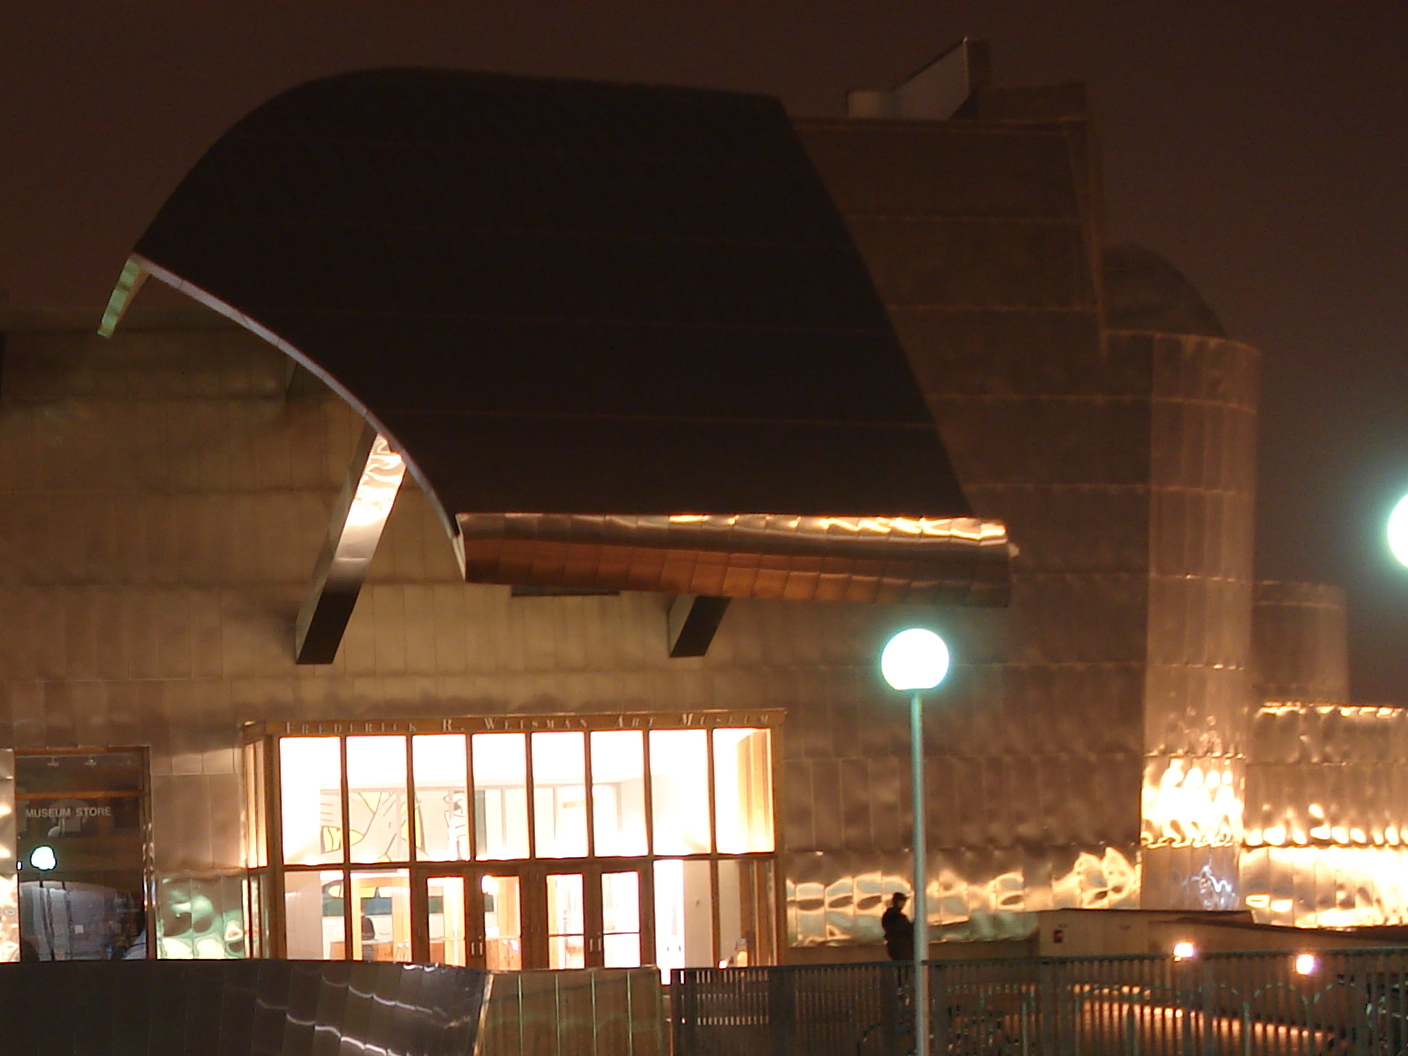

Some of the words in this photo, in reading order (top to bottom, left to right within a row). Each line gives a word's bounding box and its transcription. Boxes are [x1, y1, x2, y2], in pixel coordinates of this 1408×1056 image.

[285, 720, 417, 734] FREDERICK
[441, 718, 464, 732] R.
[484, 717, 588, 731] WEISMAN
[614, 714, 657, 728] ART
[680, 712, 770, 727] MUSEUM
[25, 807, 72, 818] MUSEUM
[75, 806, 112, 817] STORE
